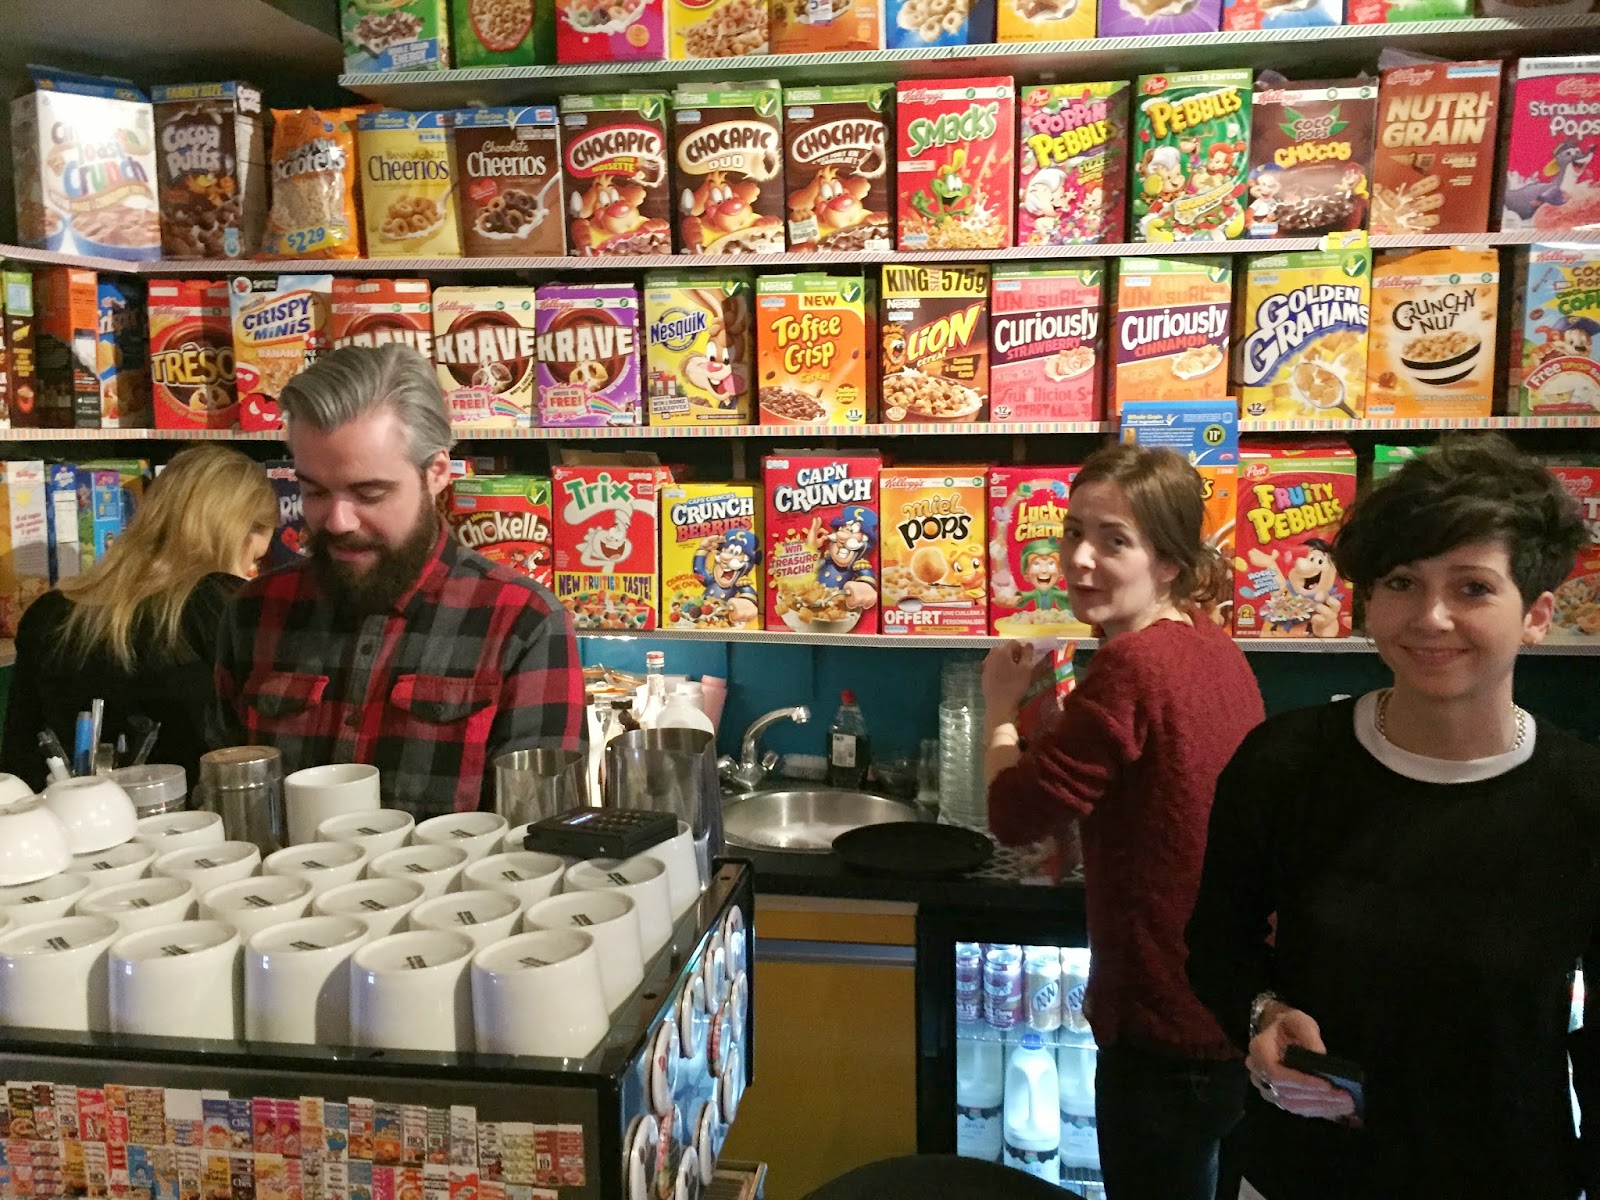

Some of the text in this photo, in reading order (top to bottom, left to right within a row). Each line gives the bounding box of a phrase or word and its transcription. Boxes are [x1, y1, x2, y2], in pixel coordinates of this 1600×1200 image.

[1145, 76, 1167, 92] Post
[1210, 72, 1248, 80] EDITION
[1147, 87, 1243, 139] PEBBLES
[1293, 114, 1336, 131] COCO
[162, 125, 220, 152] Cocoa
[685, 127, 773, 164] CHOCAPIC
[796, 122, 886, 160] CHOCAPIC
[1295, 127, 1331, 142] POPS
[1382, 117, 1487, 148] GRAIN
[481, 139, 529, 154] Chocolate
[572, 131, 657, 168] CHOCAPIC
[1274, 141, 1352, 168] CHOCOS
[166, 146, 221, 180] Puffs
[368, 155, 450, 181] Cheerios
[466, 151, 547, 177] Cheerios
[708, 154, 745, 170] DUO
[63, 156, 149, 198] Crunch
[885, 269, 929, 293] KING
[941, 267, 988, 293] 575g
[1377, 276, 1423, 291] Kellogg's
[242, 295, 313, 331] CRISPY
[437, 301, 475, 316] Kellogg's
[804, 296, 837, 306] NEW
[1257, 284, 1361, 330] GOLDEN
[1392, 287, 1477, 331] CRUNCHY
[650, 310, 707, 345] Nesquik
[771, 313, 842, 347] Toffee
[994, 307, 1099, 353] Curiously
[1120, 305, 1228, 351] Curiously
[1420, 312, 1460, 334] NUT
[435, 327, 535, 364] KRAVE
[536, 325, 634, 363] KRAVE
[785, 339, 836, 374] Crisp
[1007, 337, 1081, 360] STRAWBERRY
[1135, 334, 1208, 358] CINNAMON
[1243, 301, 1369, 386] GRAHAMS
[1530, 362, 1562, 387] Free
[452, 398, 486, 409] FREE!
[550, 396, 582, 407] FREE!
[998, 406, 1008, 414] 12
[1251, 403, 1262, 412] 12
[797, 462, 849, 487] CAP'N
[884, 478, 925, 489] Kellogg's
[1246, 465, 1268, 479] Post
[564, 472, 634, 511] Trix
[773, 478, 873, 513] CRUNCH
[1253, 482, 1334, 510] FRUITY
[671, 497, 755, 526] CRUNCH
[1018, 501, 1068, 523] Lucky
[1247, 498, 1344, 545] PEBBLES
[676, 515, 753, 542] BERRIES
[1015, 523, 1064, 542] Charm
[558, 575, 653, 600] NEW FRUITIER TASTE!
[884, 610, 943, 625] OFFERT
